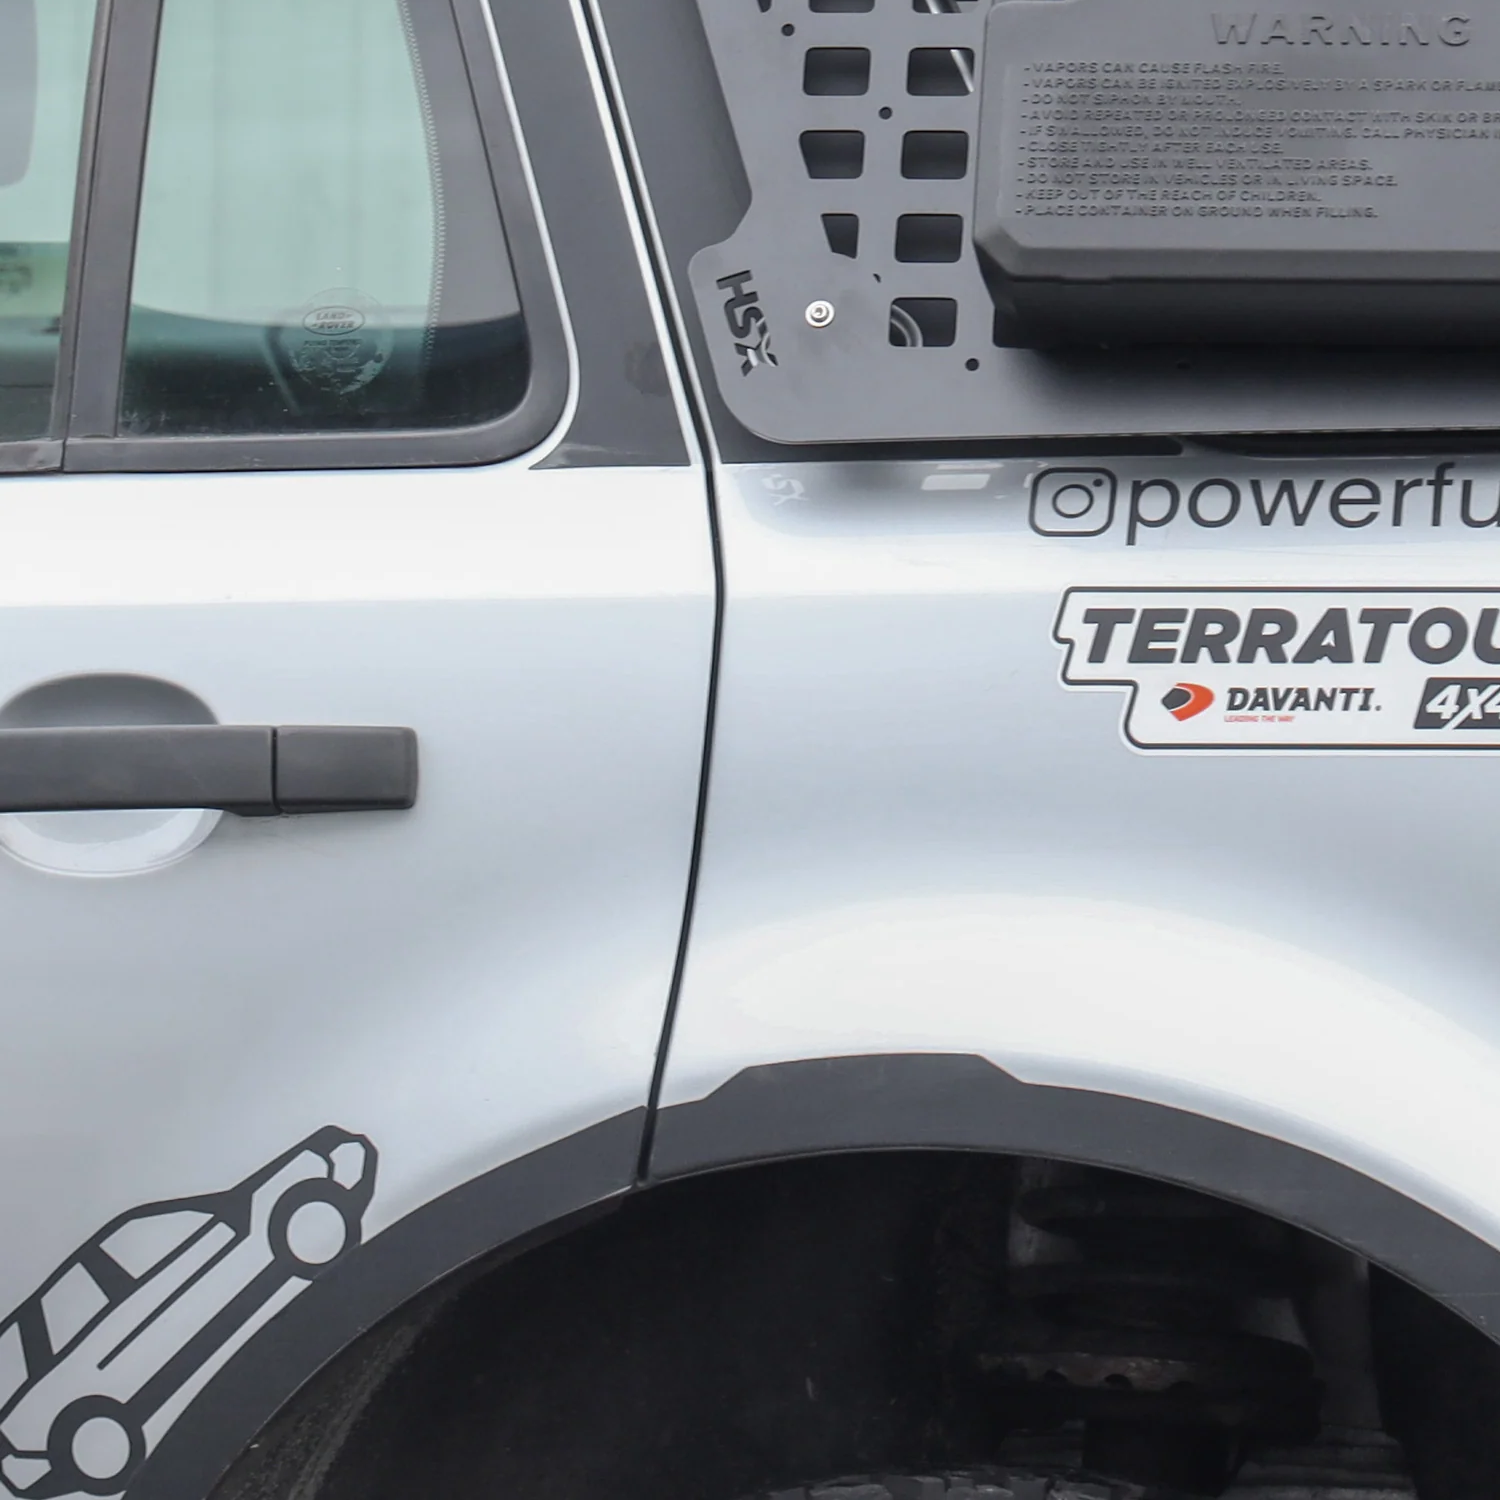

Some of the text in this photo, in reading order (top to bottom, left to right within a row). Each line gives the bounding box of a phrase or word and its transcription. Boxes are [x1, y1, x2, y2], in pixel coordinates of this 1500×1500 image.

[1210, 12, 1471, 47] WARNING
[1102, 62, 1134, 74] CAN
[1138, 62, 1191, 74] CAUSE
[1193, 62, 1243, 75] FLASH
[1101, 78, 1134, 90] CAN
[1138, 78, 1157, 90] BE
[1226, 78, 1332, 92] EXPLOSIVELY
[1334, 79, 1354, 92] BY
[1358, 79, 1369, 92] A
[1373, 79, 1427, 92] SPARK
[1430, 80, 1452, 92] OR
[1056, 93, 1093, 105] NOT
[1156, 94, 1176, 106] BY
[1083, 109, 1164, 122] REPEATED
[1167, 109, 1189, 122] OR
[1194, 109, 1287, 123] PROLONGED
[1289, 110, 1369, 123] CONTACT
[1372, 111, 1411, 124] WITH
[1414, 111, 1452, 124] SKIN
[1456, 112, 1478, 125] OR
[1152, 125, 1175, 138] DO
[1178, 126, 1213, 138] NOT
[1214, 126, 1273, 139] INDUCE
[1362, 127, 1401, 140] CALL
[1403, 127, 1490, 140] PHYSICIAN
[1080, 141, 1149, 153] TIGHTLY
[1152, 141, 1200, 154] AFTER
[1205, 142, 1246, 154] EACH
[1082, 157, 1116, 169] AND
[1119, 157, 1150, 169] USE
[1172, 157, 1213, 170] WELL
[1215, 157, 1314, 171] VENTILATED
[1051, 172, 1087, 185] NOT
[1088, 172, 1141, 185] STORE
[1163, 173, 1238, 186] VEHICLES
[1242, 174, 1263, 186] OR
[1287, 174, 1338, 187] LIVING
[1067, 189, 1101, 201] OUT
[1103, 189, 1124, 201] OF
[1126, 189, 1157, 201] THE
[1160, 189, 1213, 202] REACH
[1216, 190, 1237, 202] OF
[1077, 204, 1169, 218] CONTAINER
[1171, 205, 1194, 218] ON
[1197, 205, 1264, 218] GROUND
[1268, 206, 1312, 219] WHEN
[1223, 715, 1296, 723] LEADING THE WAY
